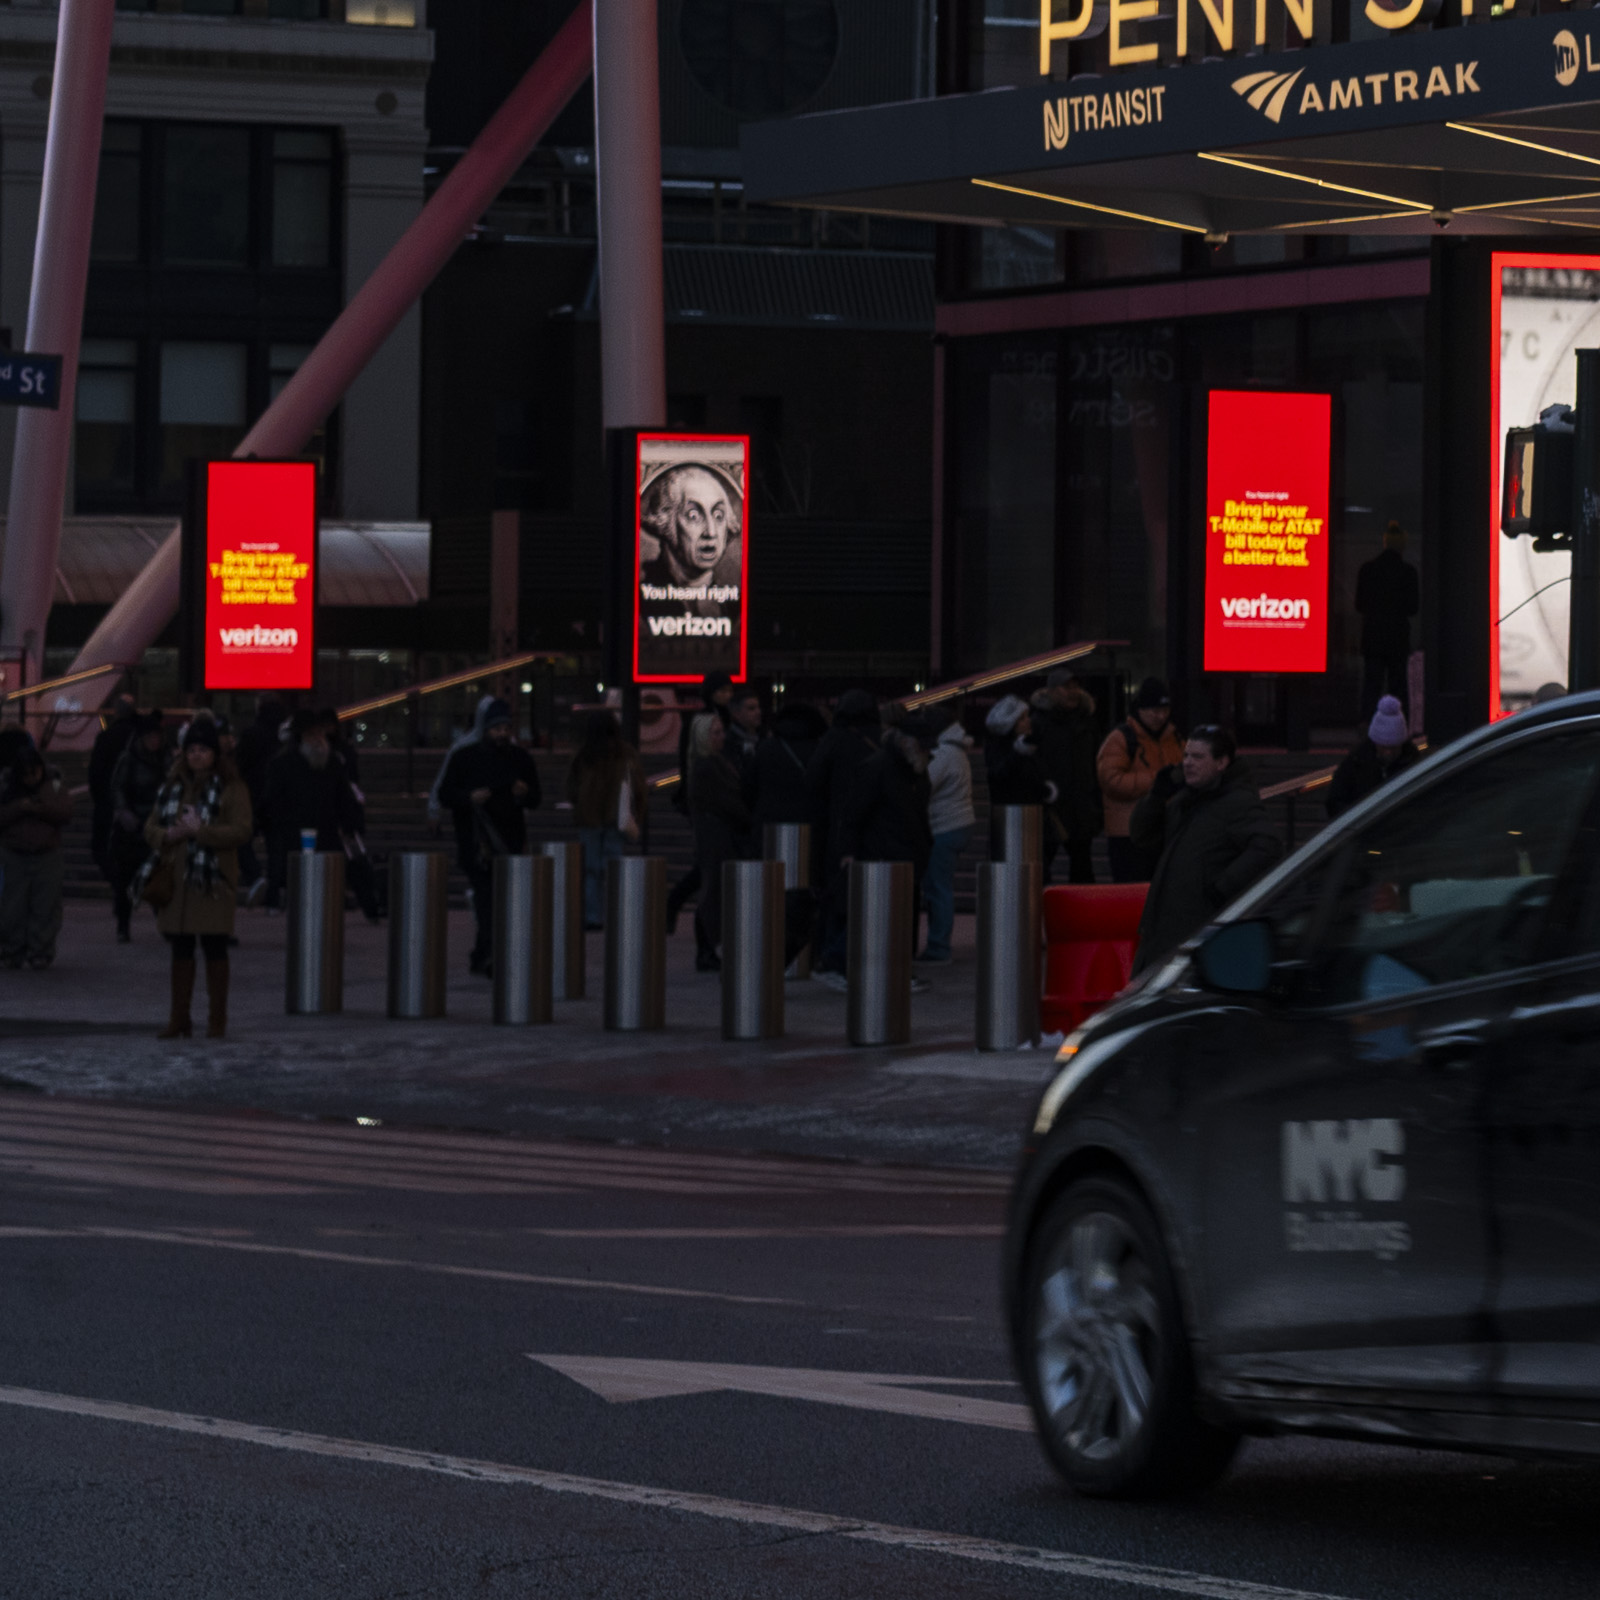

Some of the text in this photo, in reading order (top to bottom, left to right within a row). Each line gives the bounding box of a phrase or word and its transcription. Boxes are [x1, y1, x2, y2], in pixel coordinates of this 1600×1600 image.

[1299, 60, 1480, 115] AMTRAK
[1069, 86, 1166, 132] TRANSIT
[20, 367, 45, 394] St
[1225, 500, 1309, 521] Bring in your
[1209, 515, 1324, 535] T-Mobile or AT&T
[1225, 533, 1309, 552] bill today for
[1233, 549, 1275, 565] better
[641, 583, 739, 603] You heard right
[1220, 593, 1310, 619] verizon
[219, 623, 298, 647] verizon
[647, 611, 731, 636] verizon
